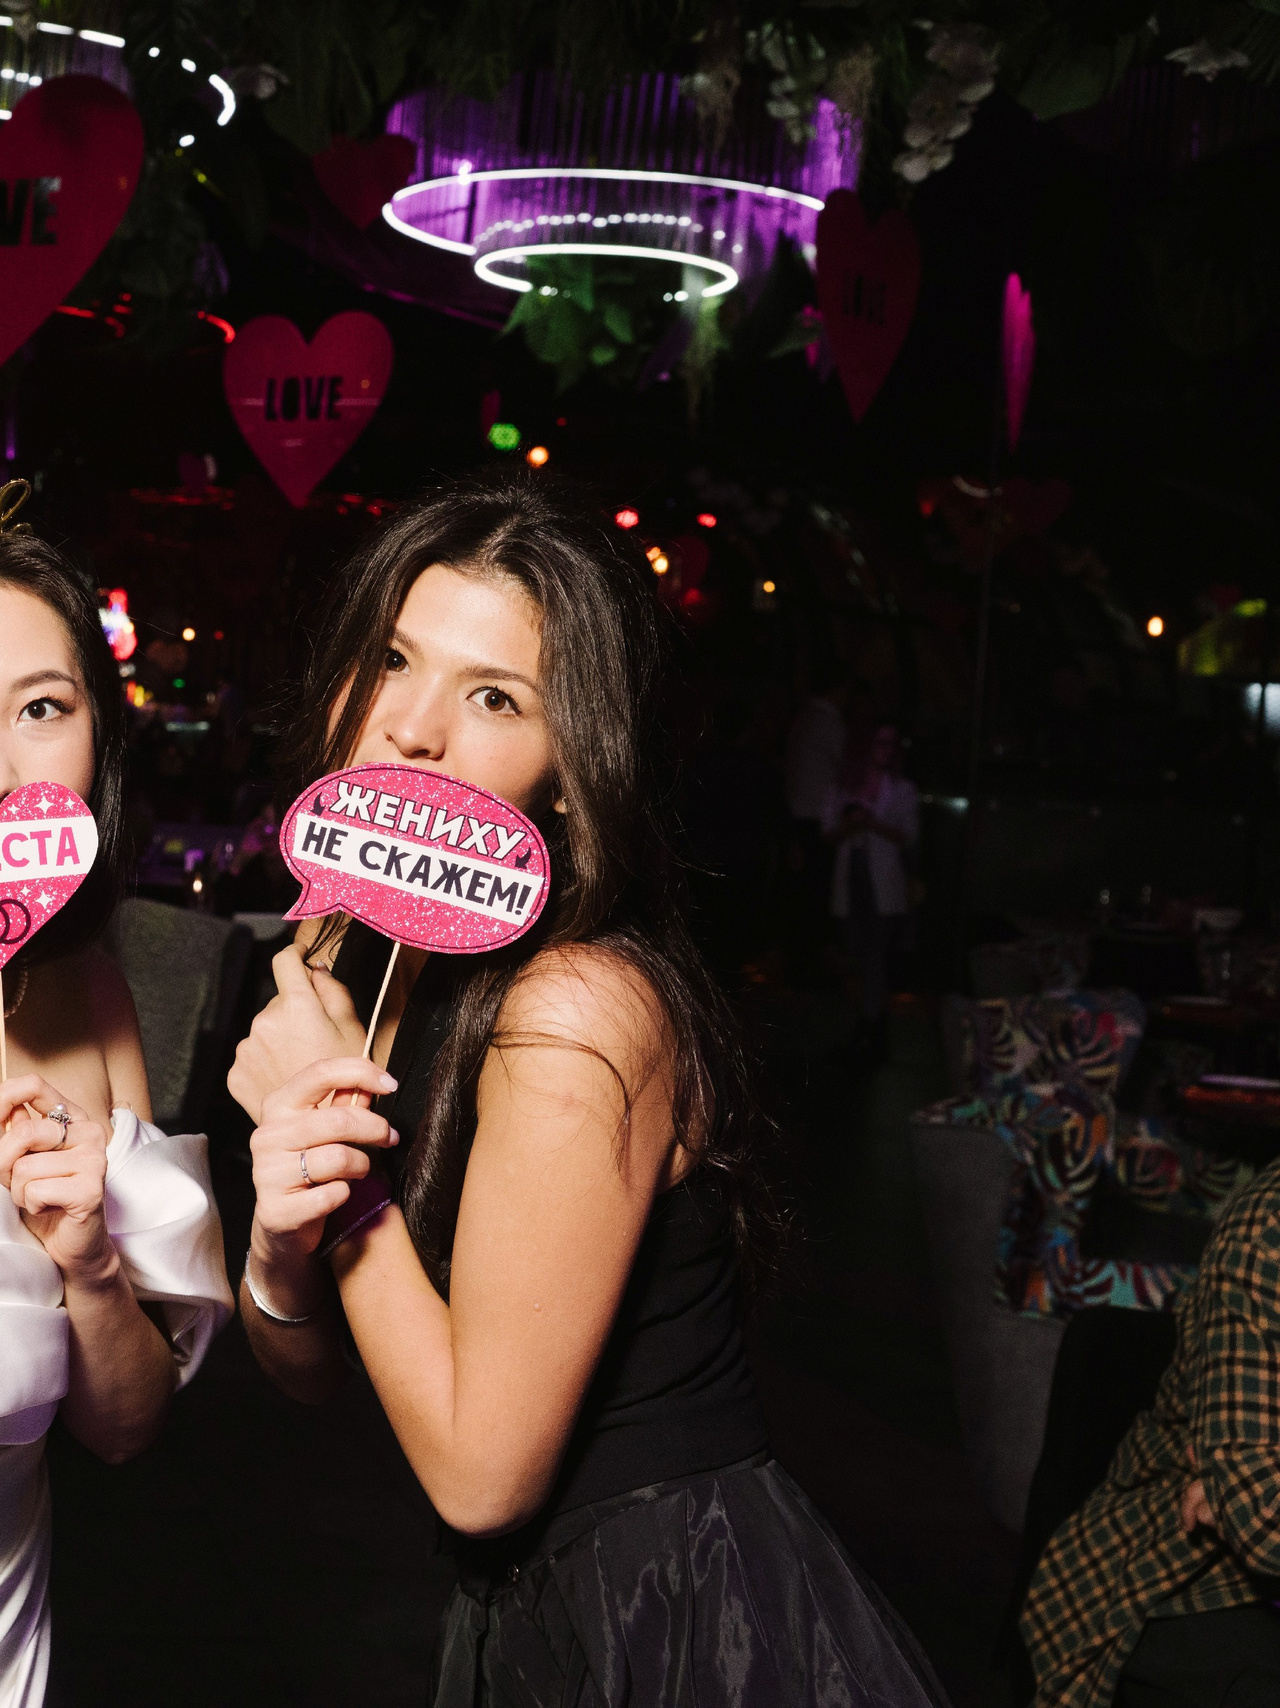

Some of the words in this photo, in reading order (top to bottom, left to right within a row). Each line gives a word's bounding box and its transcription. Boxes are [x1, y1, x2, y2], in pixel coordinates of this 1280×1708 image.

[266, 377, 342, 420] LOVE
[330, 780, 527, 860] ЖЕНИХУ
[301, 821, 348, 861] НЕ
[359, 840, 532, 916] СКАЖЕМ!
